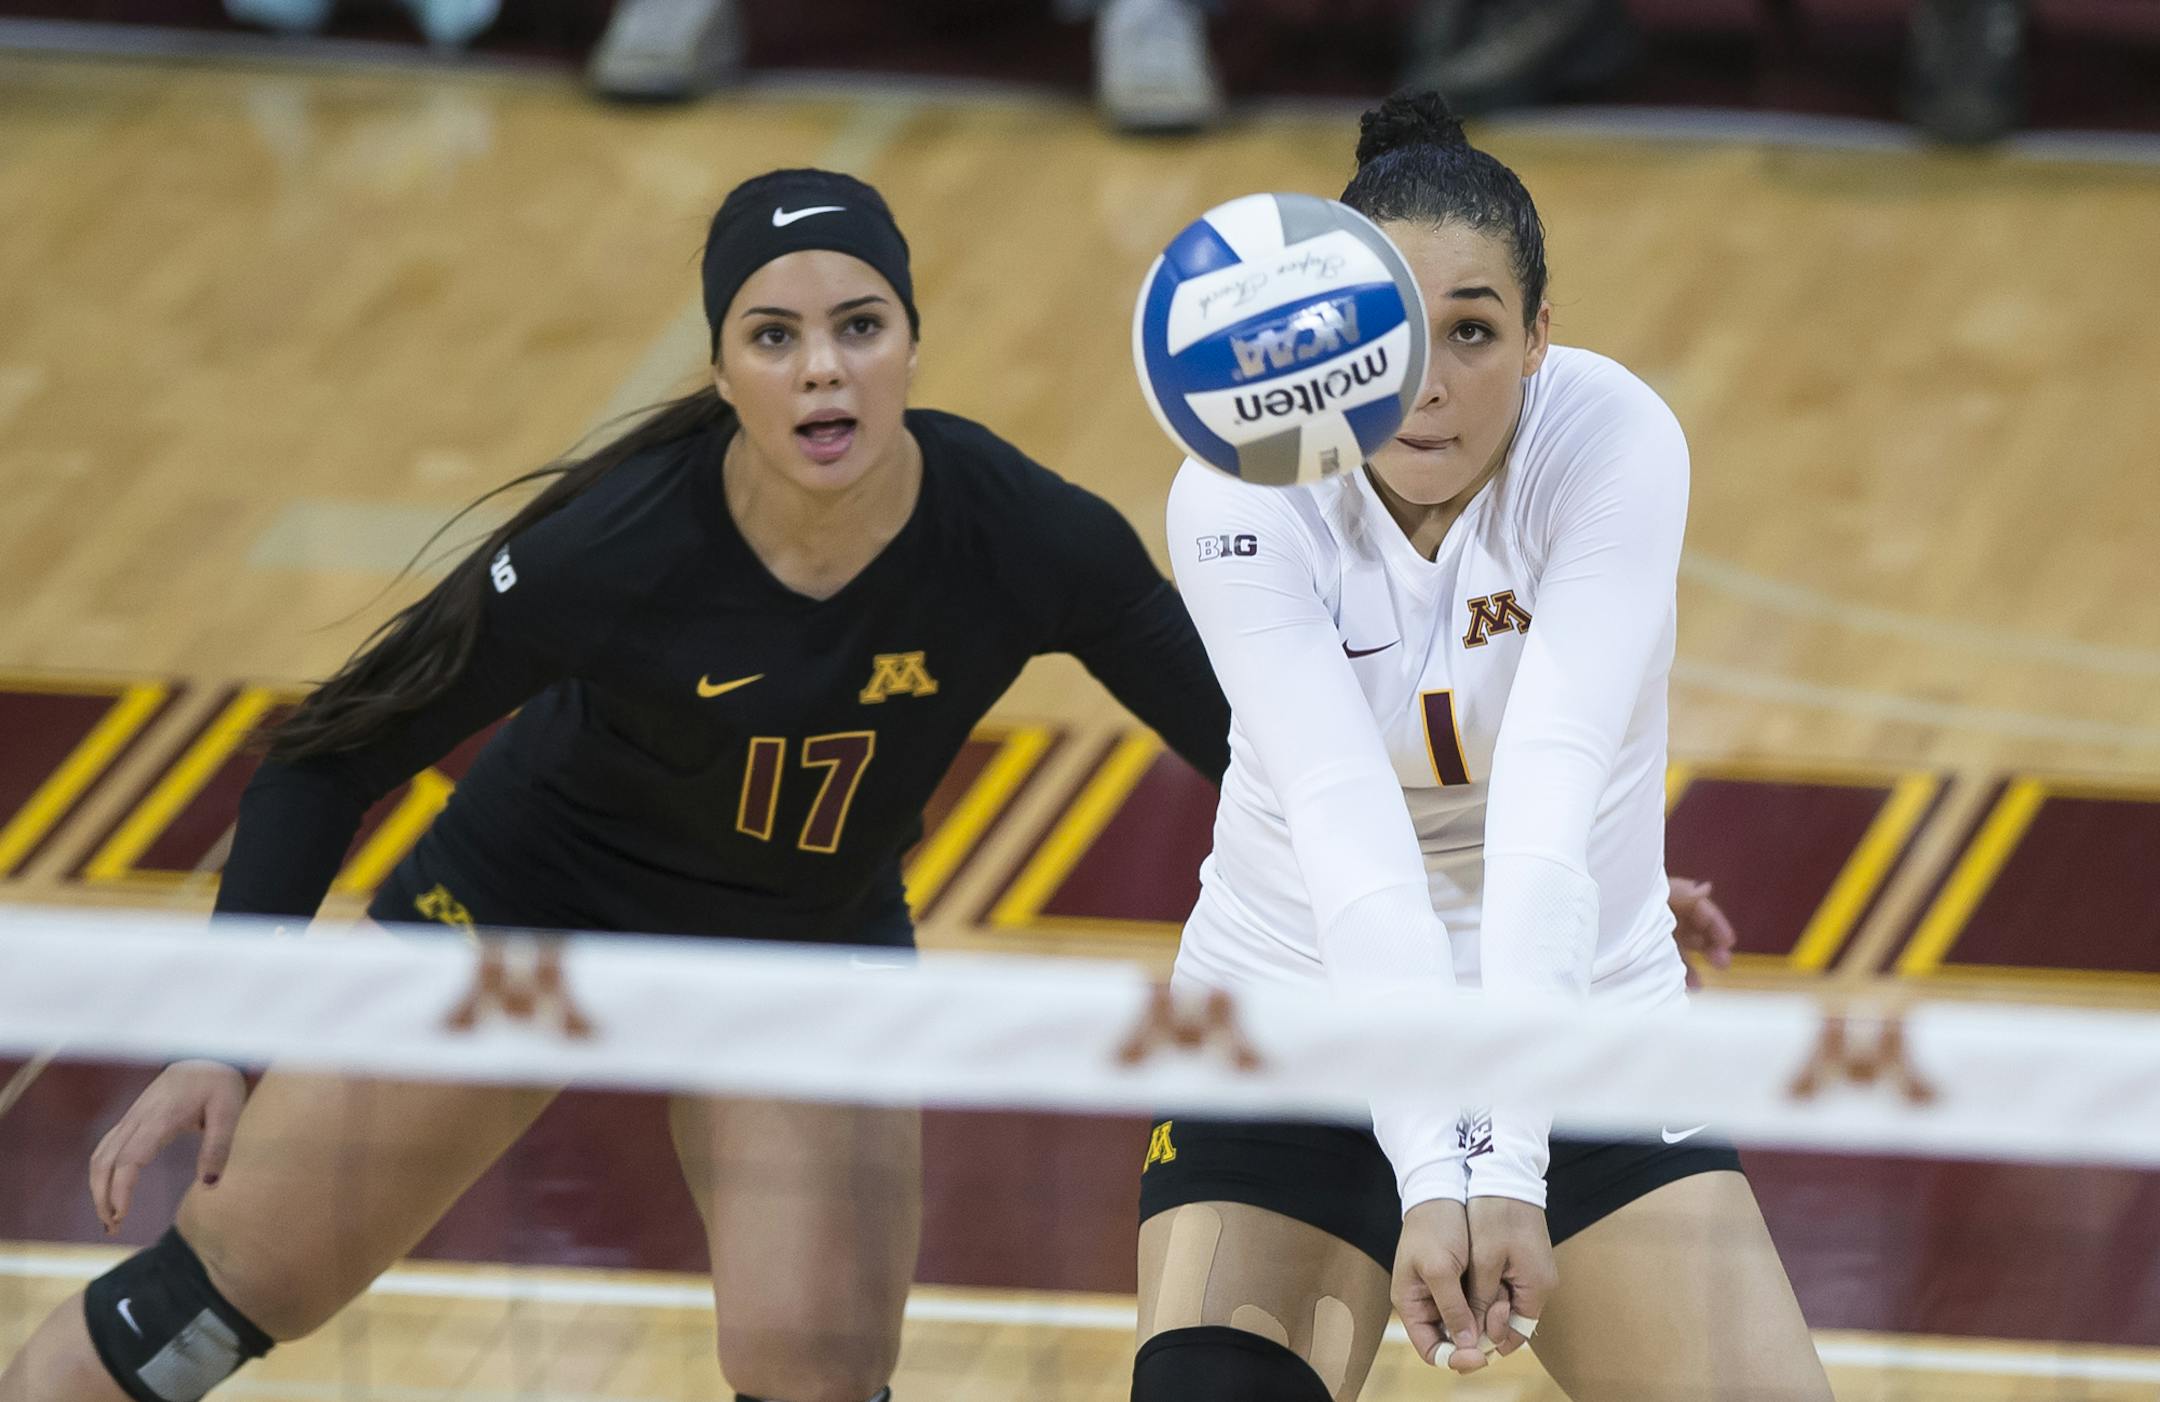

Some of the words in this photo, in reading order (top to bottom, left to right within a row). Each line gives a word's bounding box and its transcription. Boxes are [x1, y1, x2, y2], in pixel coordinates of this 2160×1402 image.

[1230, 296, 1361, 379] NCAA
[1235, 347, 1388, 422] molten
[1462, 589, 1533, 649] M
[860, 650, 938, 704] M
[1419, 687, 1472, 786] 1
[736, 730, 876, 853] 17
